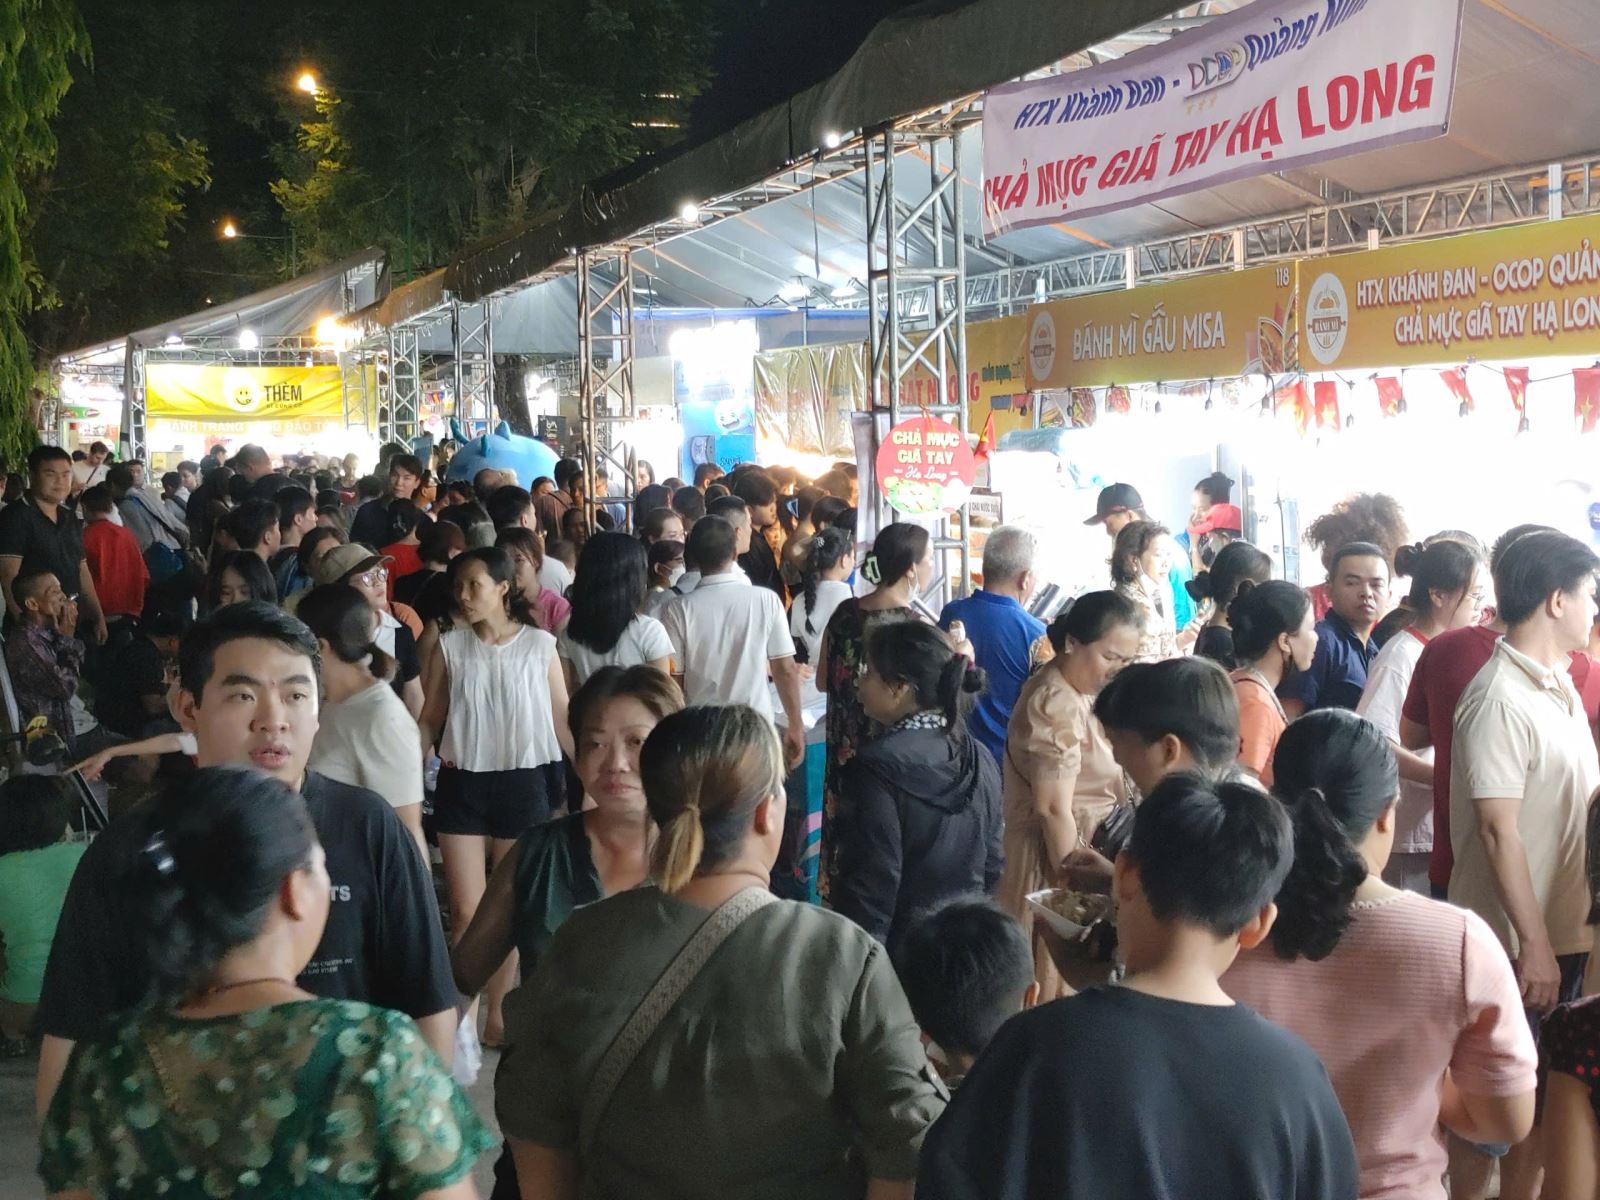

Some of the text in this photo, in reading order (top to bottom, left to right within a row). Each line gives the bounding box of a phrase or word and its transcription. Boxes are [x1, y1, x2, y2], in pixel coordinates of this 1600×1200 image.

[1013, 98, 1061, 129] HTX
[1123, 76, 1166, 110] Đan
[1036, 154, 1098, 210] MỰC
[1098, 131, 1167, 190] GIÃ
[1168, 119, 1231, 177] TAY
[1226, 96, 1284, 160] HẠ
[1297, 54, 1435, 140] LONG
[1275, 267, 1290, 288] 118
[1356, 278, 1384, 308] HTX
[1388, 268, 1439, 305] KHÁNH
[1442, 267, 1476, 299] ĐAN
[1493, 257, 1544, 292] OCOP
[1072, 319, 1113, 361] BÁNH
[1119, 313, 1140, 356] MÌ
[1182, 311, 1226, 351] MISA
[1395, 305, 1424, 345] CHẢ
[1428, 305, 1463, 347] MỰC
[1466, 302, 1493, 338] GIÃ
[1497, 304, 1528, 336] TAY
[1532, 298, 1559, 338] HẠ
[264, 382, 302, 402] THÈM
[892, 428, 960, 449] CHẢ MỰC
[898, 448, 954, 465] GIÃ TAY
